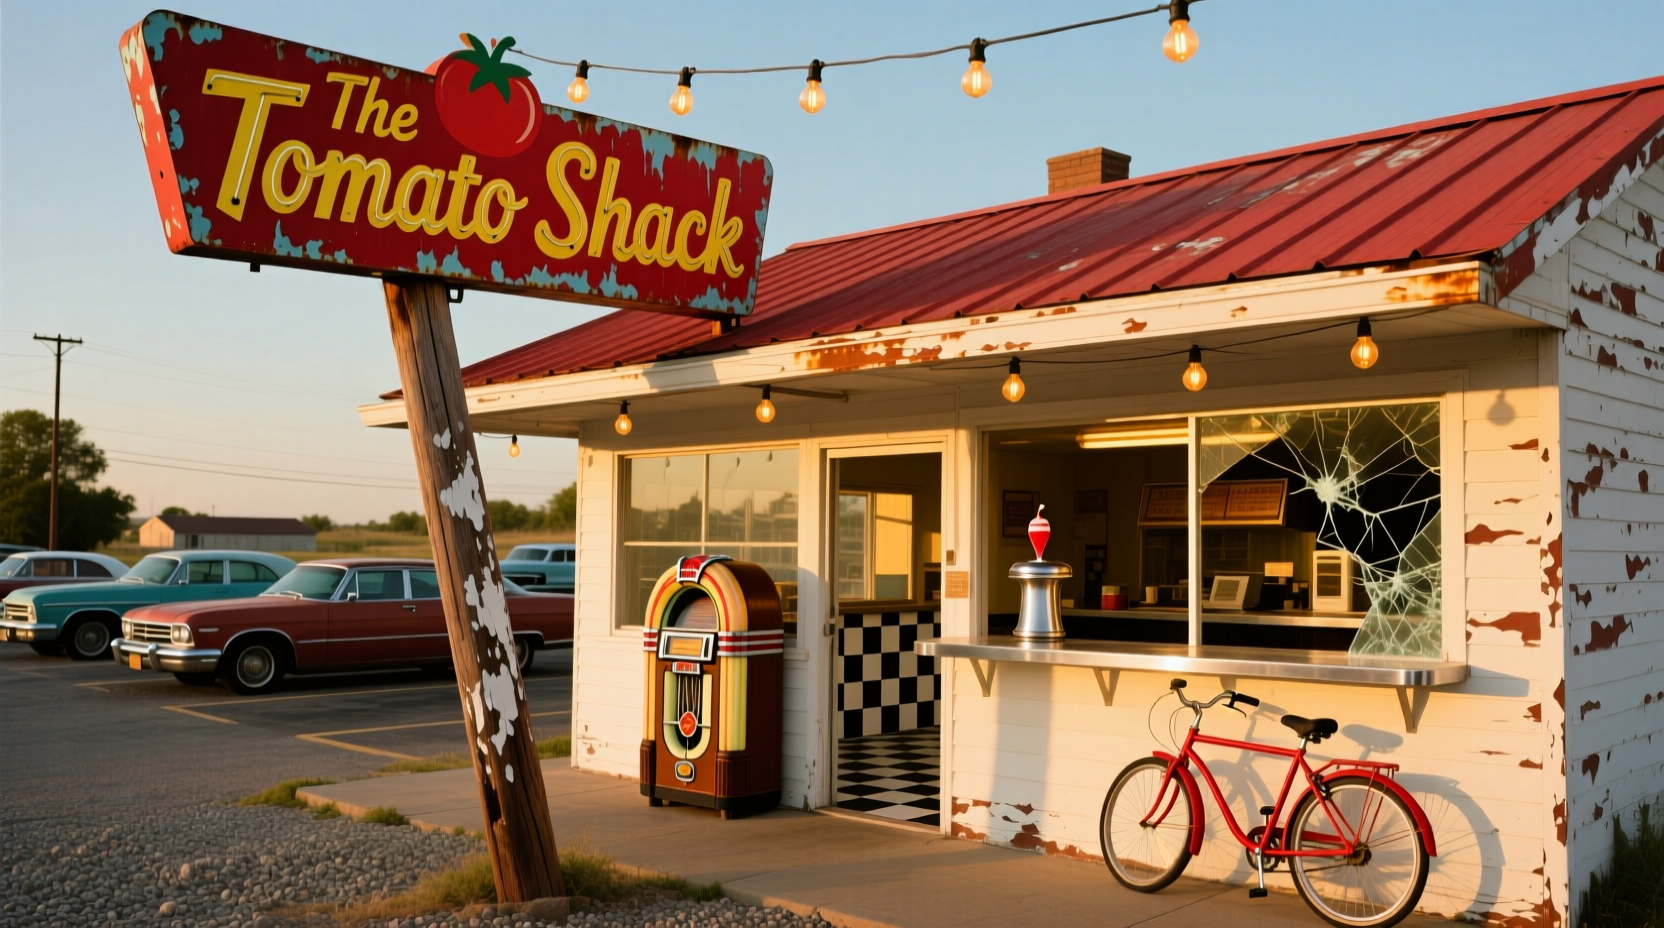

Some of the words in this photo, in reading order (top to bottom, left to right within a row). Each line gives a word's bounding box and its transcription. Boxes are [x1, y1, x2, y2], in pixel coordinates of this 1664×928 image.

[202, 68, 528, 244] Tomato
[534, 141, 744, 278] Shack
[326, 72, 419, 141] The
